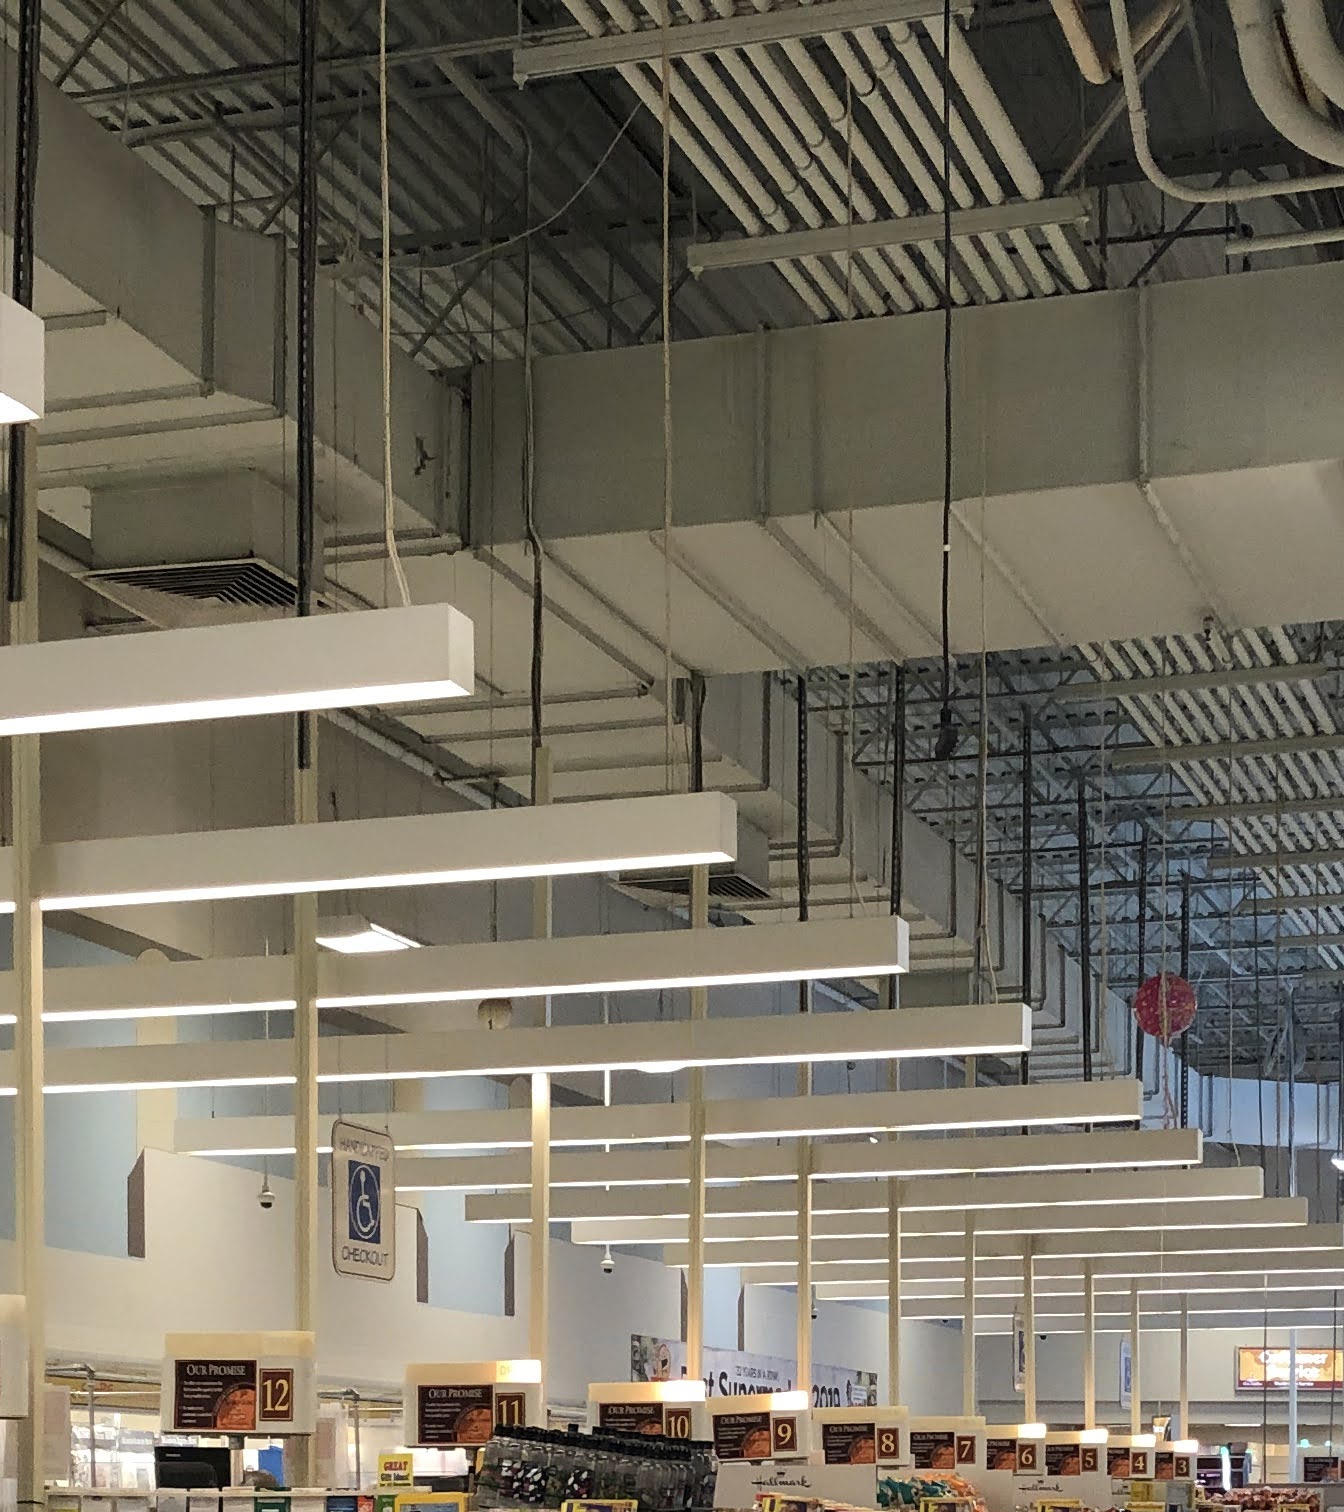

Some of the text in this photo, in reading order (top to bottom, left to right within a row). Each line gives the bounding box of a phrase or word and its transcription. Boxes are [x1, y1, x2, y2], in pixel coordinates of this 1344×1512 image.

[342, 1246, 389, 1266] CHECKOUT
[186, 1364, 246, 1376] OUR PROMISE
[264, 1379, 289, 1412] 12
[499, 1400, 521, 1426] 11
[669, 1414, 689, 1438] 10
[777, 1423, 792, 1445] 9
[882, 1432, 895, 1453] 8
[960, 1441, 971, 1459] 7
[1022, 1447, 1033, 1465] 6
[1084, 1451, 1094, 1467] 5
[1135, 1454, 1145, 1470] 4
[1178, 1460, 1187, 1474] 3
